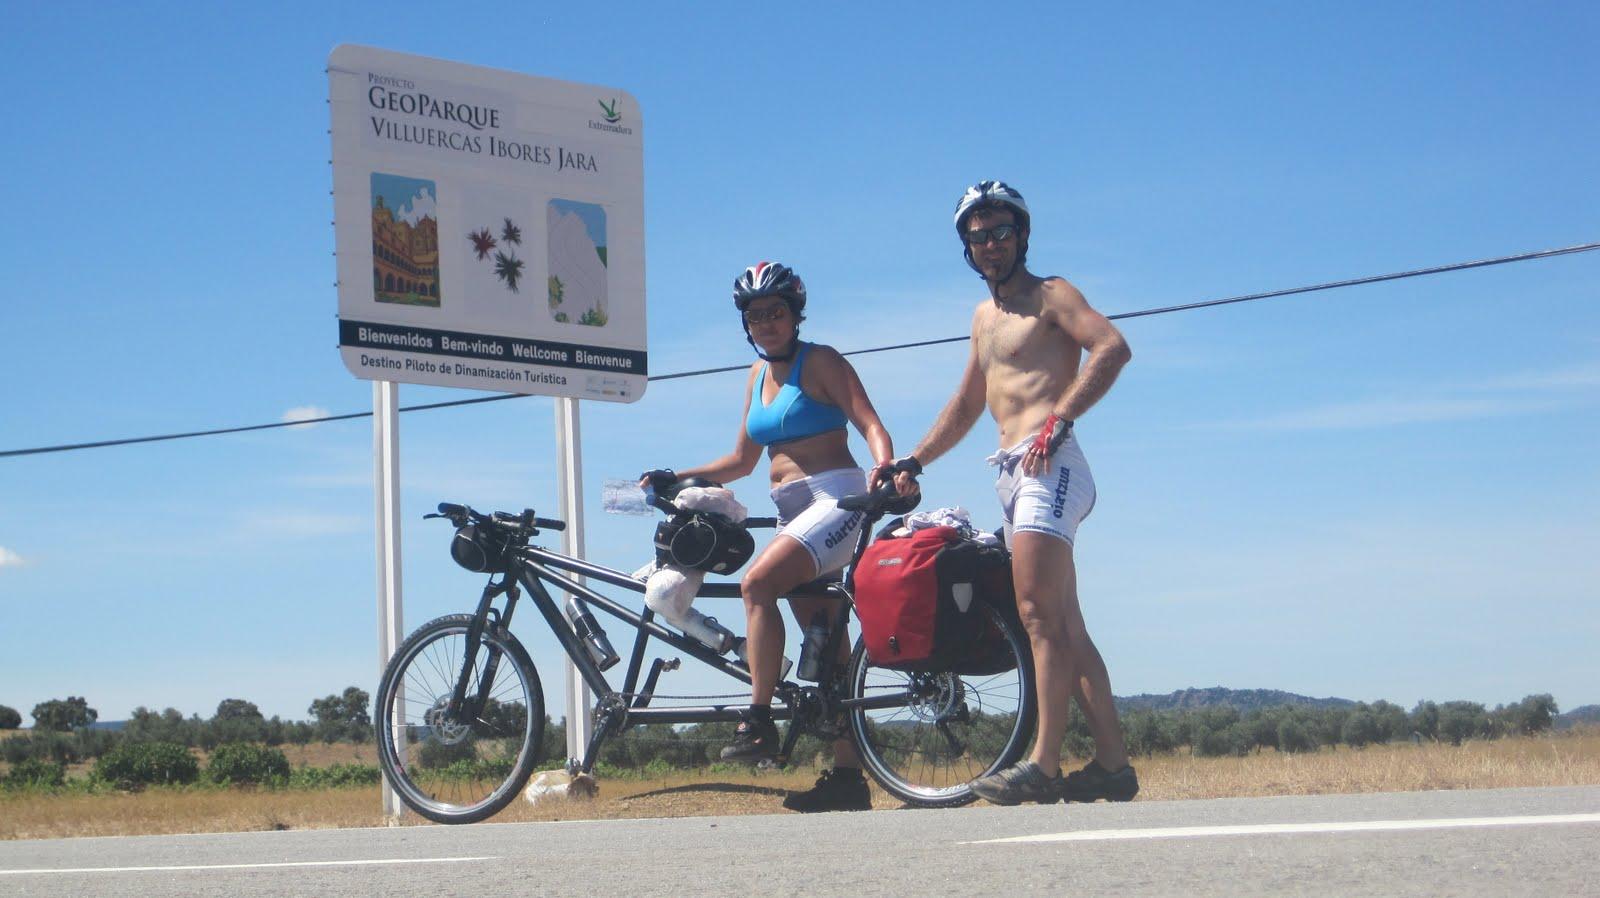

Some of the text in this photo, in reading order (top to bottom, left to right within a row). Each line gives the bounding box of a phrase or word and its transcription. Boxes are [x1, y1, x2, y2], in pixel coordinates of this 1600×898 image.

[588, 119, 632, 135] Extremadura
[358, 327, 632, 369] Bienvenidos Bem-vindo Wellcome Bienvenue
[360, 354, 402, 370] Destino
[405, 358, 436, 373] Piloto
[439, 363, 452, 375] de
